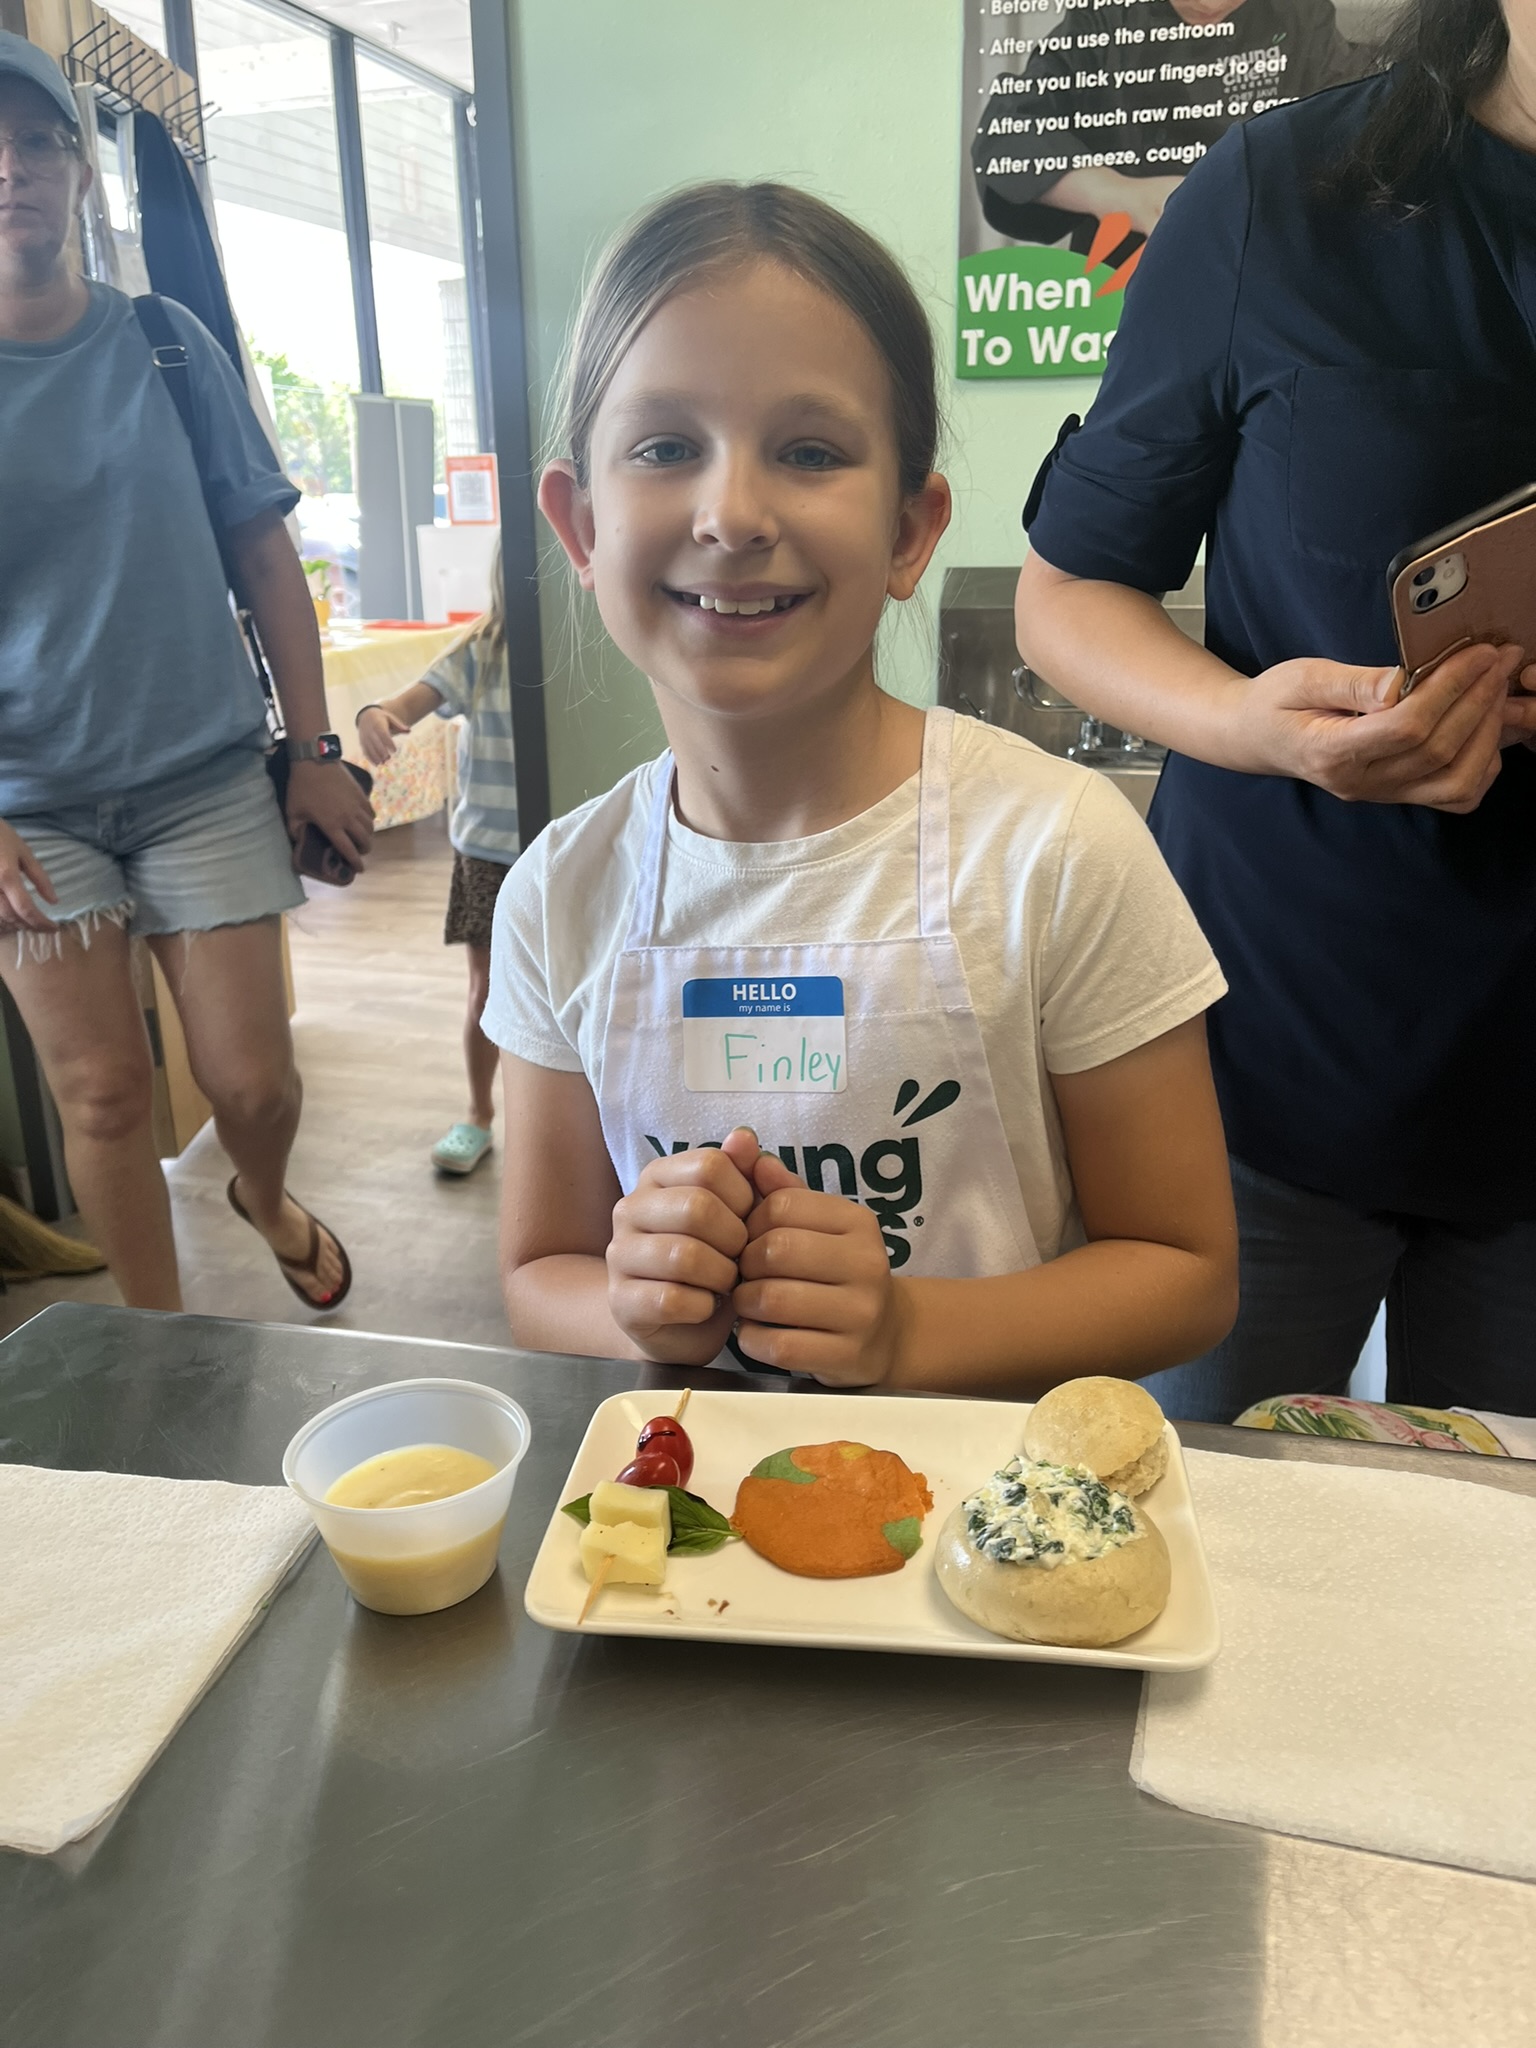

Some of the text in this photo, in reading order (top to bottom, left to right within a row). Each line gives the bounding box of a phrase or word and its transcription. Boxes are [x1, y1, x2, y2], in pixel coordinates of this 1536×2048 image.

[991, 0, 1049, 15] Before
[1055, 0, 1088, 14] you
[990, 22, 1234, 57] After you use the restroom
[989, 54, 1287, 95] After you lick your fingers to eat
[988, 118, 1031, 134] After
[1036, 117, 1069, 135] you
[1074, 109, 1127, 128] touch
[1133, 108, 1168, 123] raw
[1173, 100, 1223, 119] meat
[1228, 102, 1248, 115] or
[987, 142, 1206, 174] After you sneeze, cough
[965, 273, 1091, 312] When
[962, 329, 1012, 365] To
[734, 984, 796, 1000] HELLO
[739, 1003, 791, 1014] my name is
[725, 1033, 840, 1090] Finley
